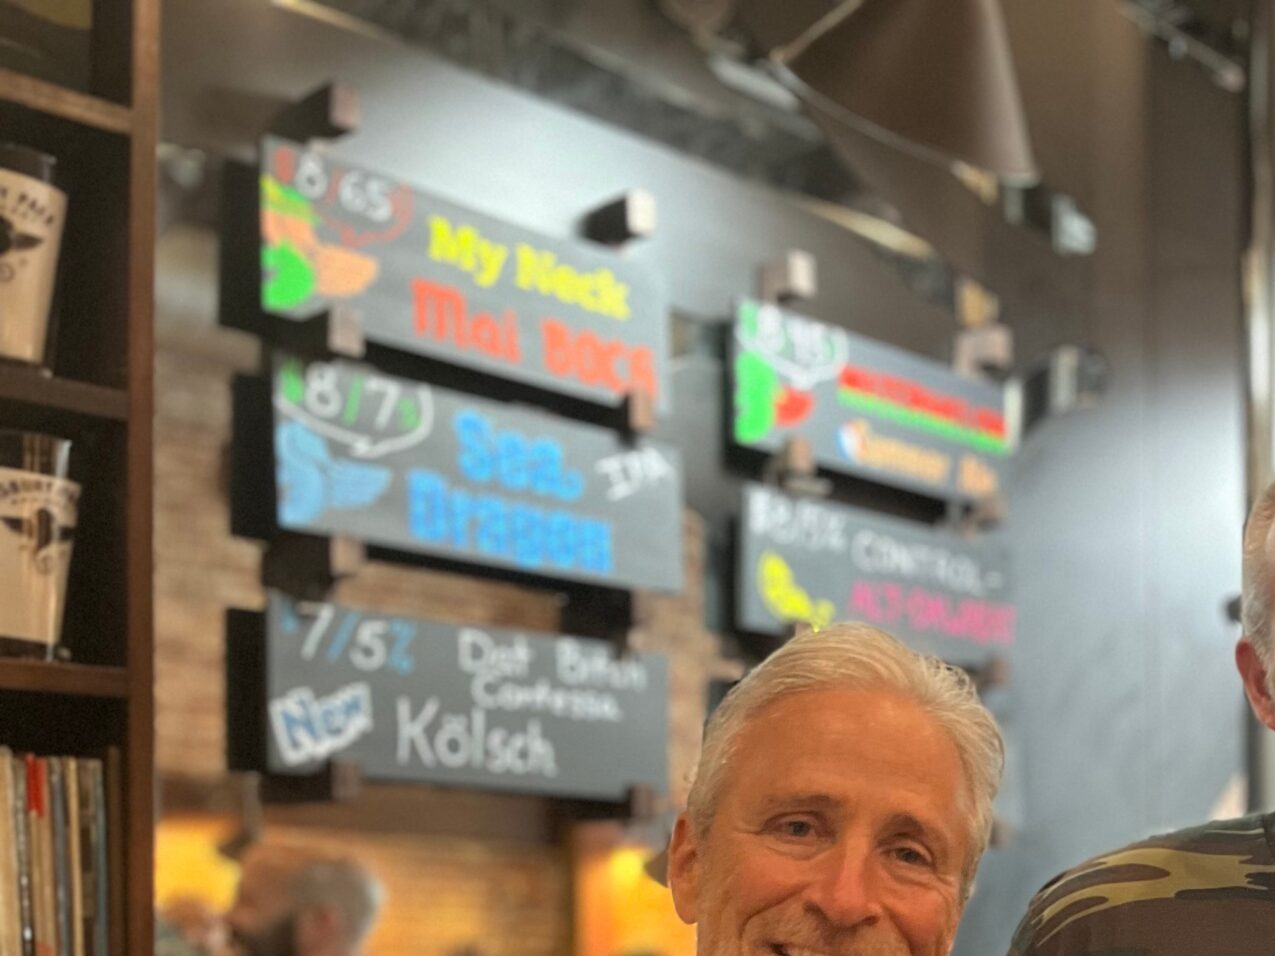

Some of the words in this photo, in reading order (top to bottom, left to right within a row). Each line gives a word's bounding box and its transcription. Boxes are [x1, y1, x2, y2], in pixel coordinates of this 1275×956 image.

[428, 213, 508, 288] My
[515, 240, 631, 320] Neck
[410, 276, 523, 364] Mai
[276, 687, 368, 755] New
[396, 696, 559, 779] Kölsch
